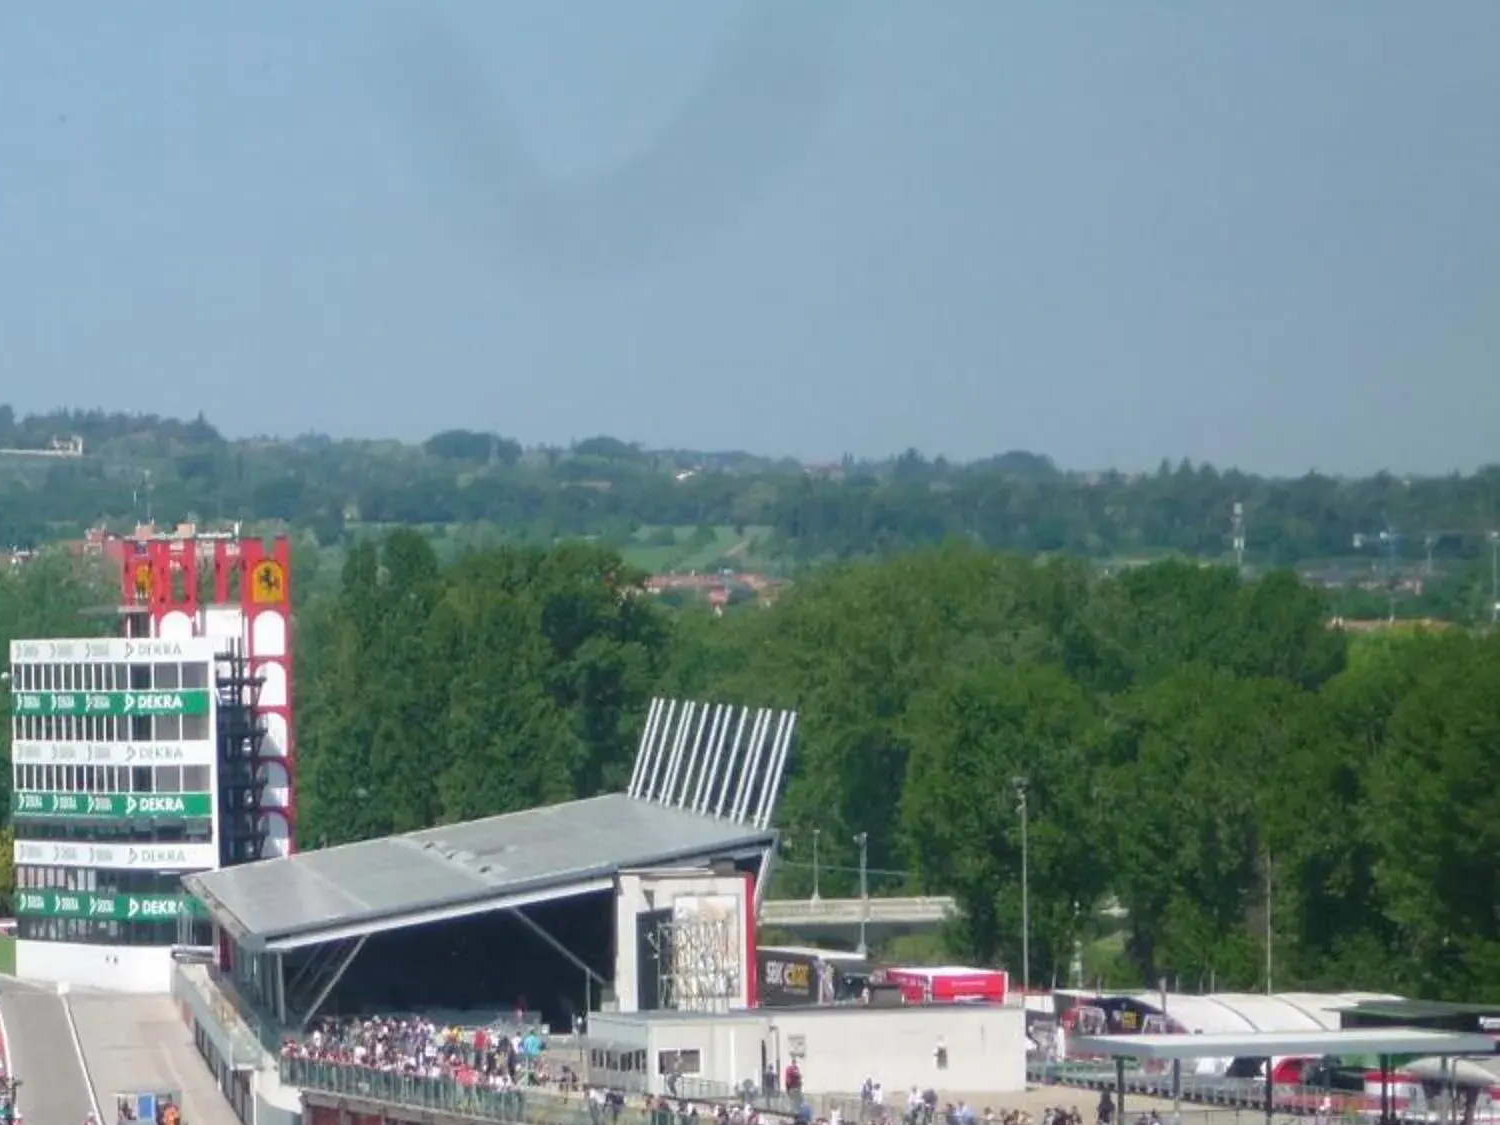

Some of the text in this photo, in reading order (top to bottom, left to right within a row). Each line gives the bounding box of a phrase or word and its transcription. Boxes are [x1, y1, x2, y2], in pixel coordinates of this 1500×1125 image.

[137, 694, 183, 710] DEKRA
[139, 797, 185, 812] DEKRA
[141, 848, 188, 863] DEKRA
